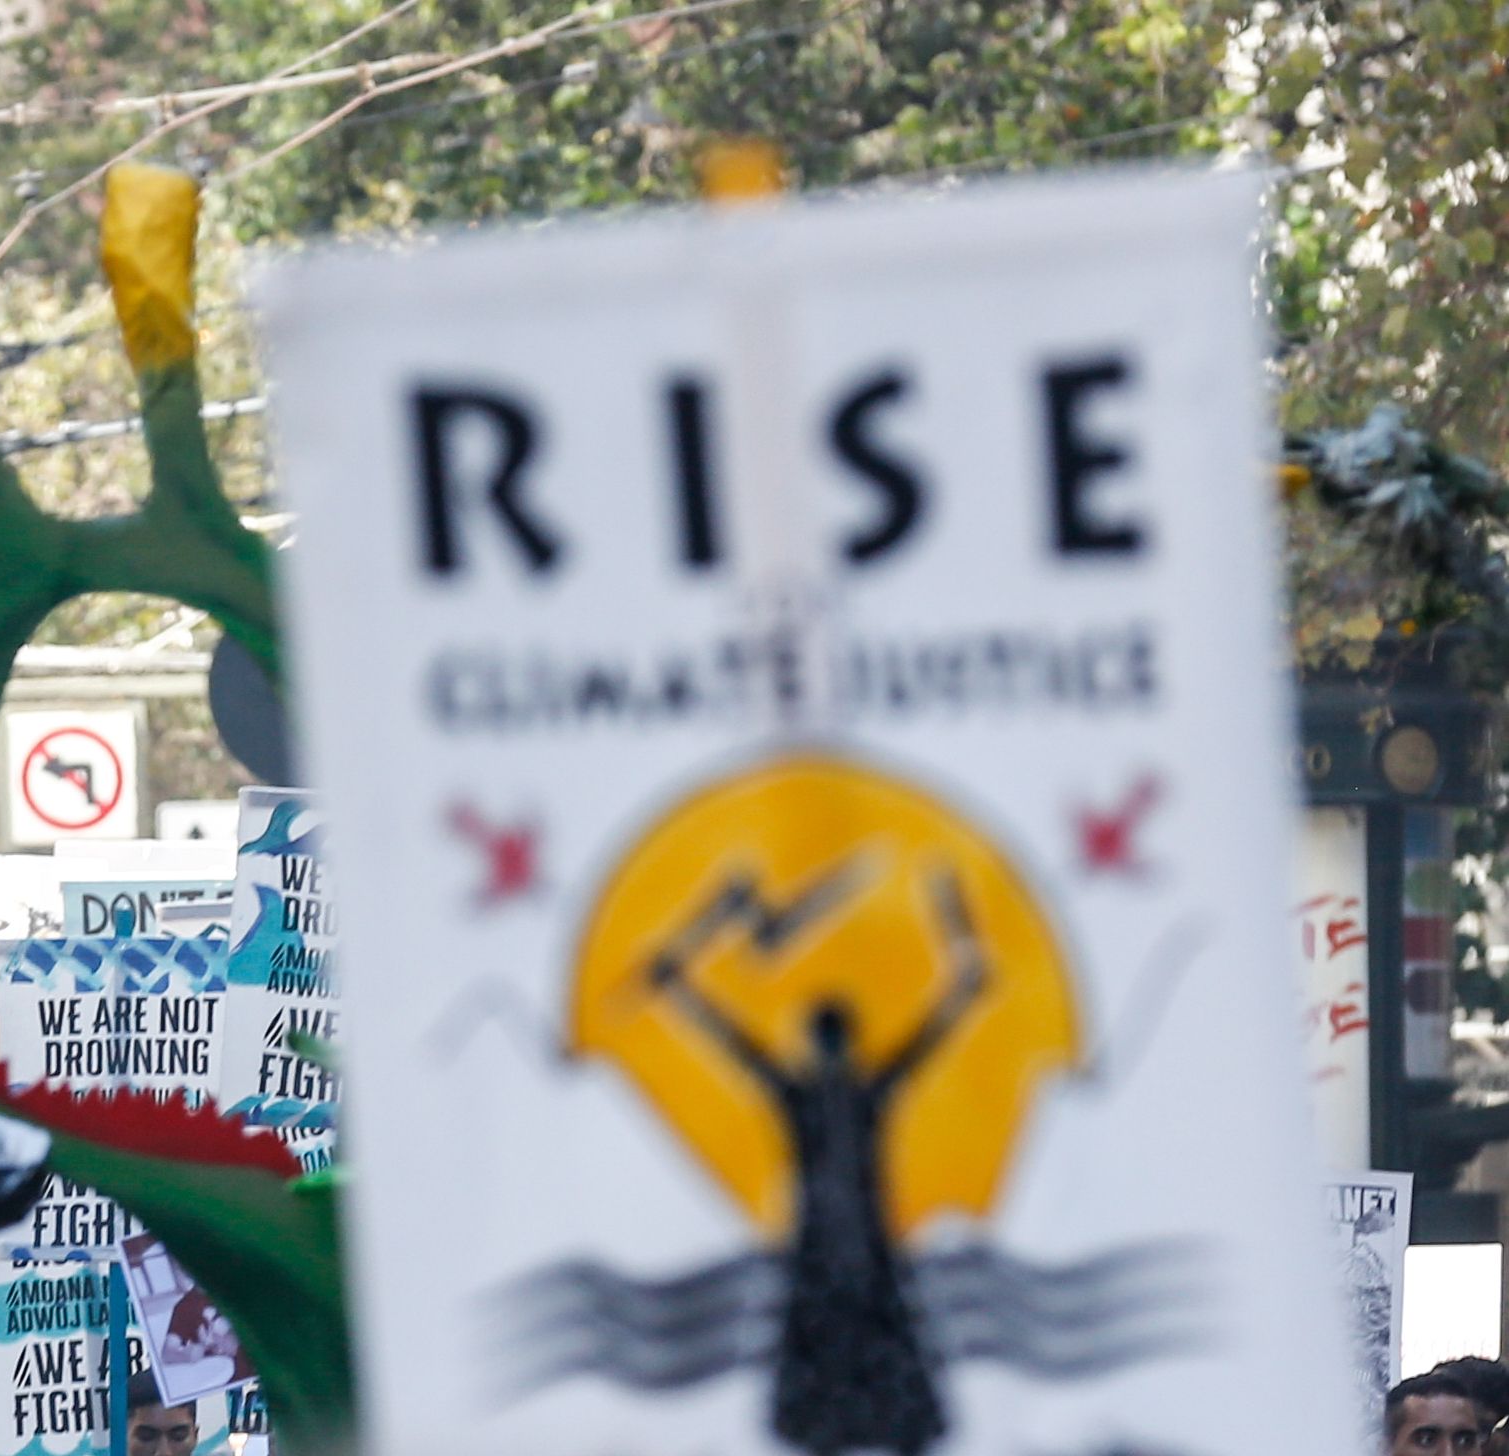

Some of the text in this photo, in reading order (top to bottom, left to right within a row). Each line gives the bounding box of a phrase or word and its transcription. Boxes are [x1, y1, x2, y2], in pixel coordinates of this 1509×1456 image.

[407, 350, 1149, 577] RISE
[39, 997, 220, 1036] WE ARE NOT
[45, 1038, 210, 1078] DROWNING
[20, 1276, 96, 1305] MOANA
[7, 1305, 81, 1334] ADWOJ
[35, 1340, 86, 1386] WE
